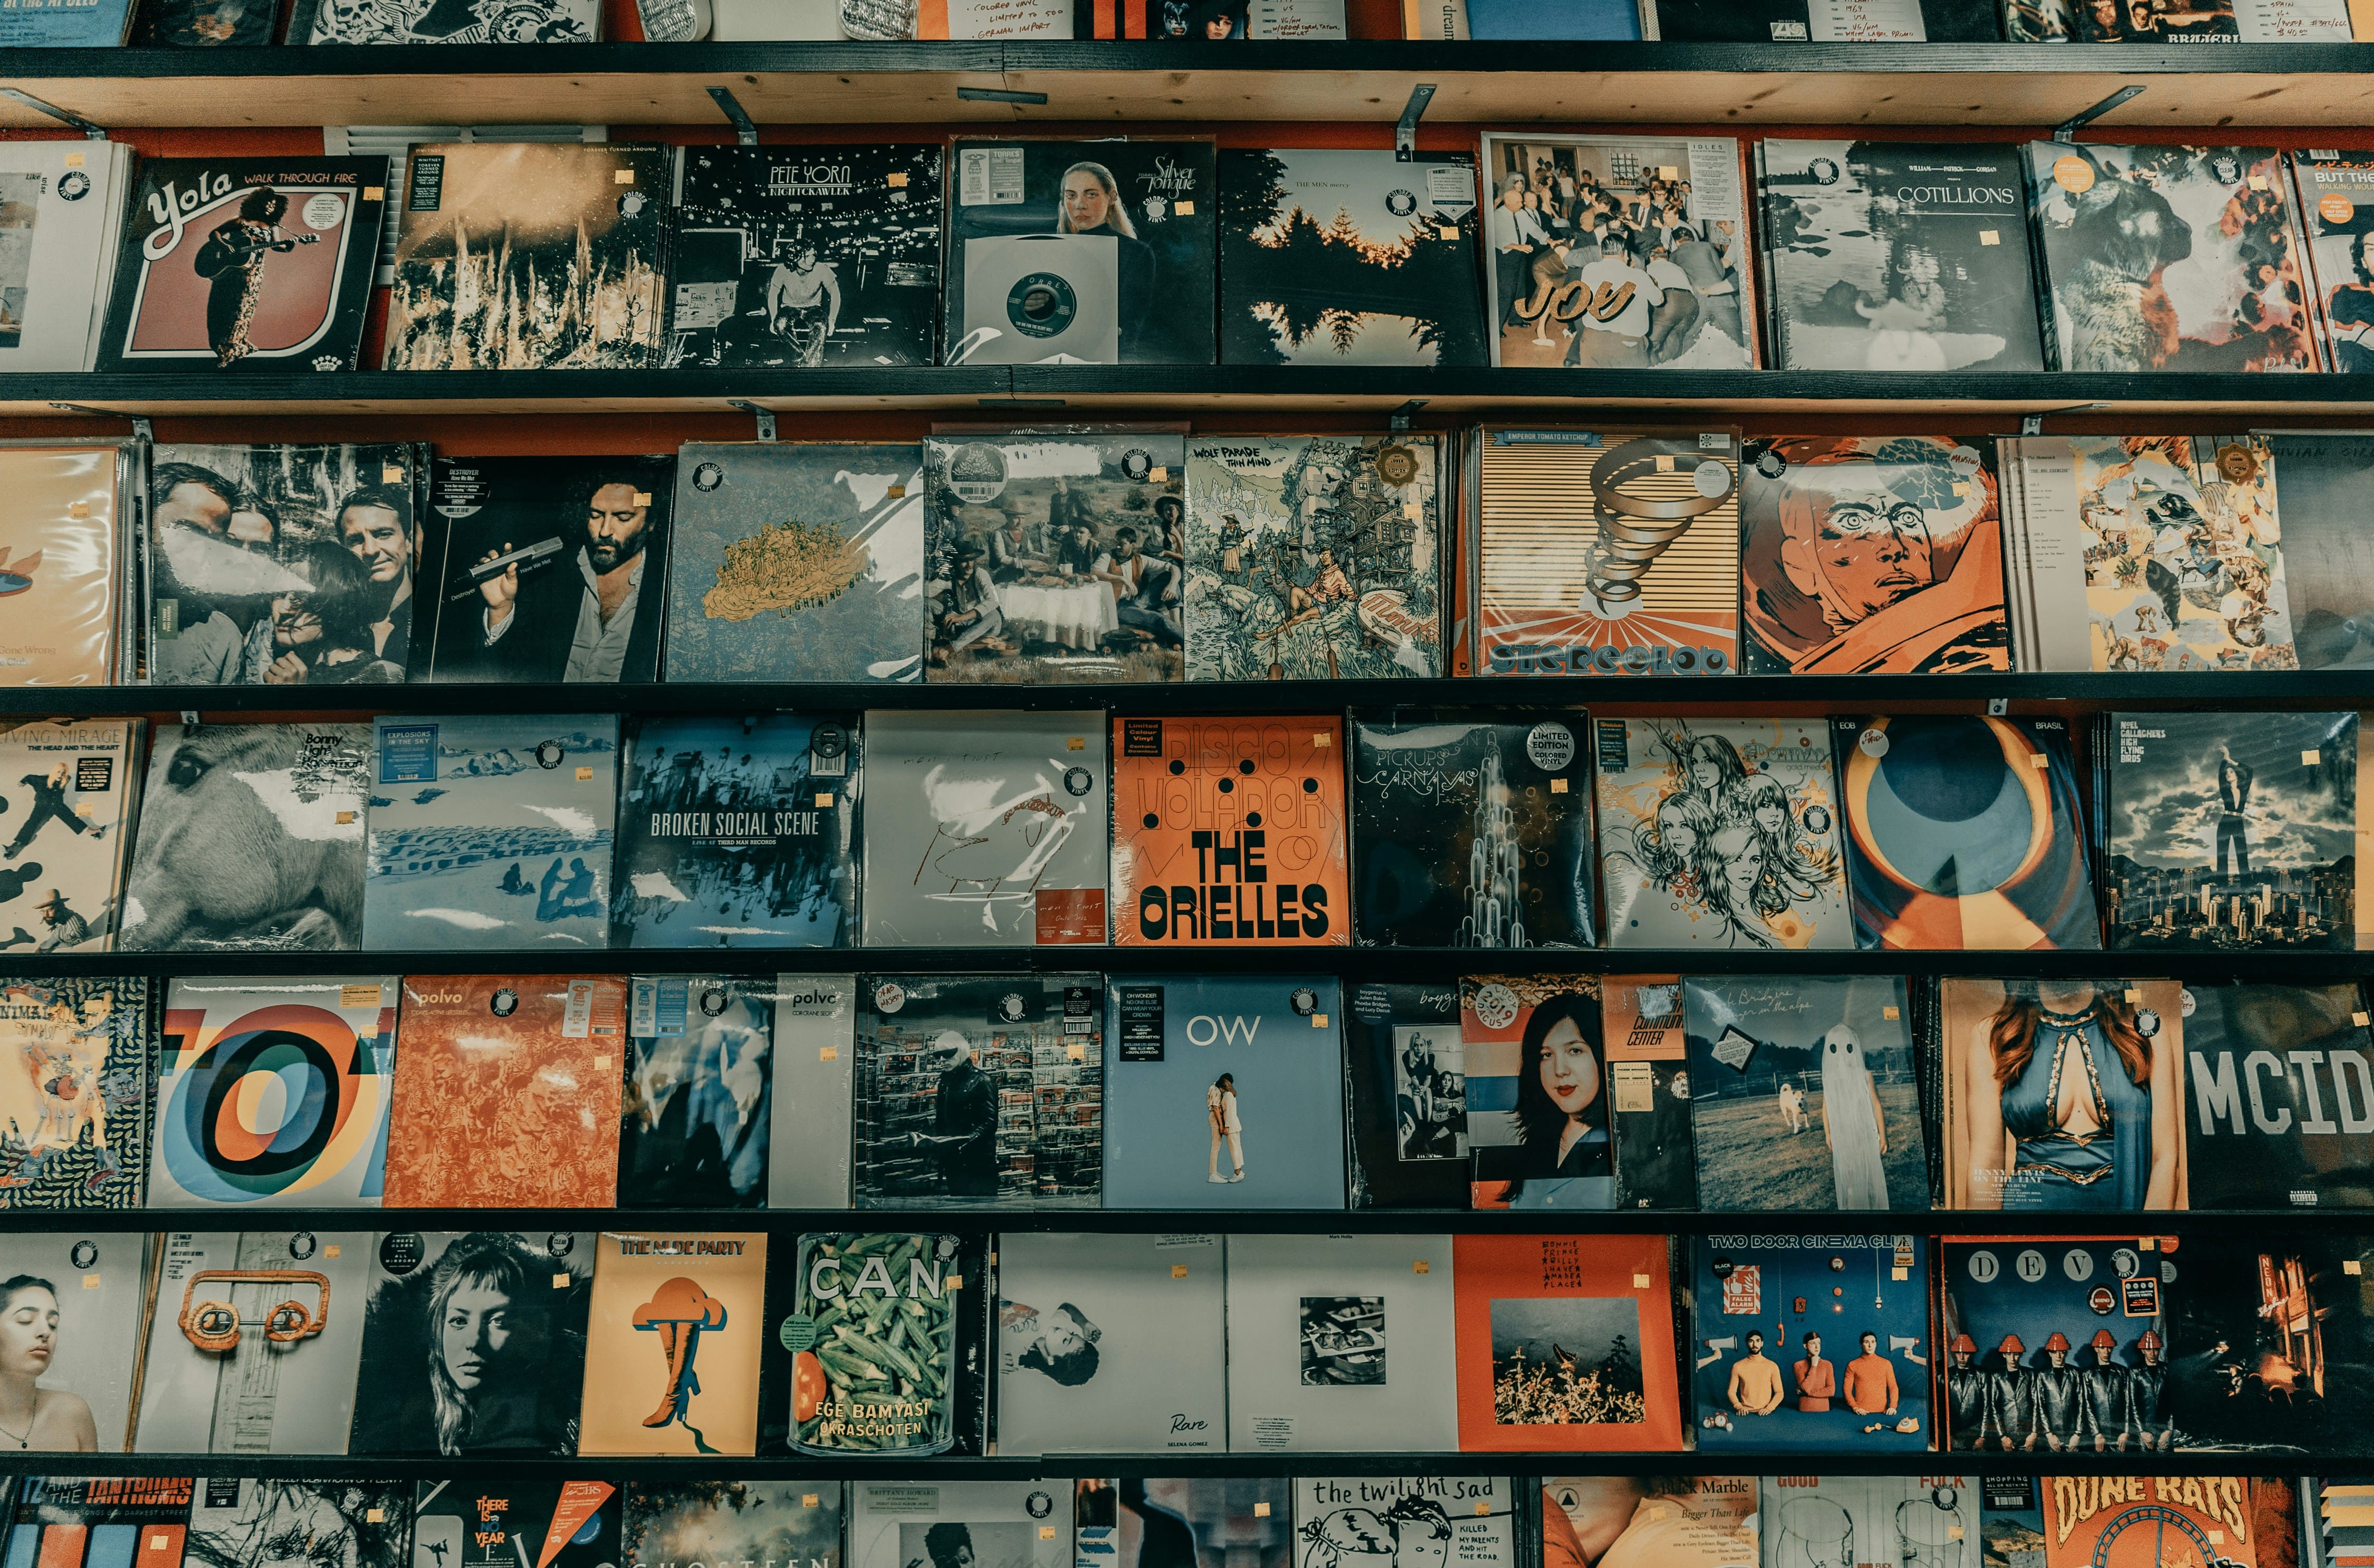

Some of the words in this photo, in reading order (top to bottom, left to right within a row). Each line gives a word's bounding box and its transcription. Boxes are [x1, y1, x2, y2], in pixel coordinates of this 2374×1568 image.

[1019, 23, 1051, 34] IMPORT
[244, 174, 274, 184] WALK
[278, 172, 331, 184] THROUGH
[333, 172, 357, 183] FIRE
[770, 166, 799, 184] PETE
[804, 165, 850, 183] YORN
[2314, 172, 2344, 183] BUT
[769, 187, 850, 196] NIGHTCRAWLER
[1388, 189, 1412, 199] COLORED
[1897, 187, 2014, 204] COTILLIONS
[143, 170, 232, 261] Yola
[1393, 207, 1412, 216] VINYL
[1562, 433, 1588, 441] KETCHUP
[1124, 448, 1148, 460] COLORED
[1193, 447, 1219, 459] WOLF
[1220, 447, 1260, 458] PARADE
[1756, 449, 1772, 469] COLORED
[1226, 458, 1246, 467] THIN
[1247, 458, 1272, 467] MIND
[700, 463, 723, 476] COLORED
[1131, 470, 1149, 478] VINYL
[1772, 462, 1786, 478] VINYL
[696, 480, 712, 492] VINYL
[451, 588, 476, 601] Destroyer
[780, 586, 841, 619] LIGHTNING
[24, 646, 56, 656] Wrong
[2120, 721, 2138, 729] NOEL
[305, 733, 343, 746] Bonny
[1533, 741, 1569, 749] EDITION
[2120, 738, 2138, 746] HIGH
[1165, 724, 1290, 776] DISCO
[2120, 746, 2145, 755] FLYING
[2120, 754, 2141, 763] BIRDS
[1137, 776, 1326, 830] VOLADOR
[651, 812, 711, 837] BROKEN
[715, 812, 770, 836] SOCIAL
[774, 812, 819, 835] SCENE
[1191, 830, 1267, 883] THE
[1140, 883, 1329, 940] ORIELLES
[419, 988, 463, 1006] polvo
[1495, 985, 1518, 1008] LUCY
[1299, 1007, 1316, 1015] VINYL
[1480, 989, 1514, 1021] 2019
[1477, 1002, 1503, 1027] DACUS
[1186, 1015, 1261, 1046] OW
[1627, 1030, 1665, 1046] CENTER
[2189, 1050, 2374, 1135] MCID
[621, 1239, 652, 1256] THE
[696, 1239, 745, 1256] PARTY
[1542, 1240, 1578, 1248] BONNIE
[1709, 1235, 1747, 1249] TWO
[1750, 1235, 1798, 1249] DOOR
[1802, 1235, 1867, 1249] CINEMA
[1544, 1248, 1579, 1256] PRINCE
[809, 1255, 941, 1300] CAN
[2262, 1257, 2274, 1297] NEON
[815, 1401, 845, 1419] EGE
[851, 1401, 929, 1419] BAMYASI
[819, 1421, 922, 1437] OKRASCHOTEN
[1170, 1413, 1209, 1435] Rare
[85, 1477, 193, 1504] TANTRUMS
[1313, 1480, 1352, 1504] the
[1359, 1477, 1449, 1502] twilight
[1452, 1478, 1494, 1499] sad
[49, 1492, 81, 1504] THE
[1681, 1508, 1707, 1519] Bigger
[1710, 1508, 1732, 1518] Than
[1734, 1507, 1750, 1518] Life
[2052, 1477, 2148, 1550] DUNE
[2154, 1476, 2247, 1545] RATS
[480, 1521, 500, 1532] NO
[1460, 1524, 1488, 1533] KILLED
